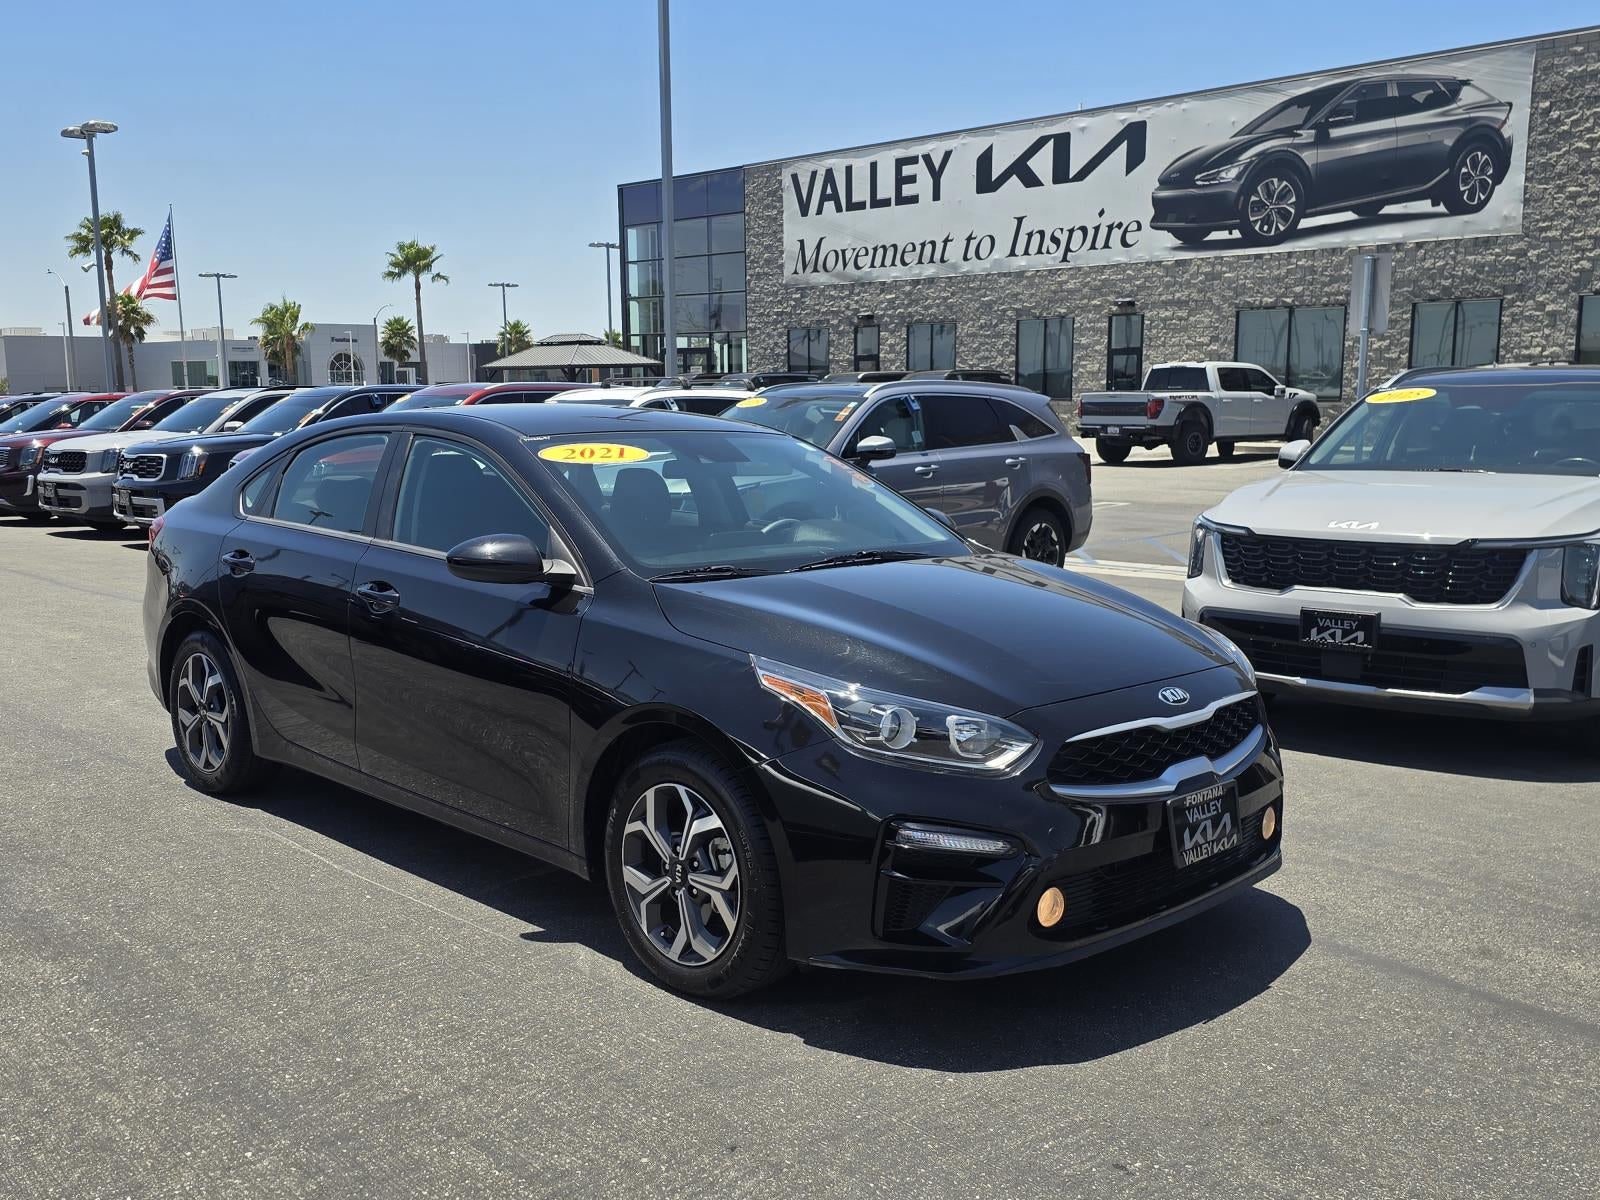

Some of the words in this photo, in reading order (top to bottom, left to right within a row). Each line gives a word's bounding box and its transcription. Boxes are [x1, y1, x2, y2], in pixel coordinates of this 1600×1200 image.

[790, 149, 953, 218] VALLEY
[976, 120, 1147, 194] KIA
[792, 232, 954, 275] Movement
[962, 230, 995, 263] to
[1006, 208, 1142, 263] Inspire
[562, 447, 625, 460] 2021
[1328, 520, 1379, 530] KIA
[1310, 627, 1365, 643] KIA
[1317, 618, 1358, 630] VALLEY
[1162, 688, 1186, 702] KIA
[1185, 785, 1223, 807] FONTANA
[1185, 799, 1222, 823] VALLEY
[1183, 812, 1232, 850] KIA
[1182, 842, 1212, 866] VALLEY
[1213, 833, 1238, 854] KIA
